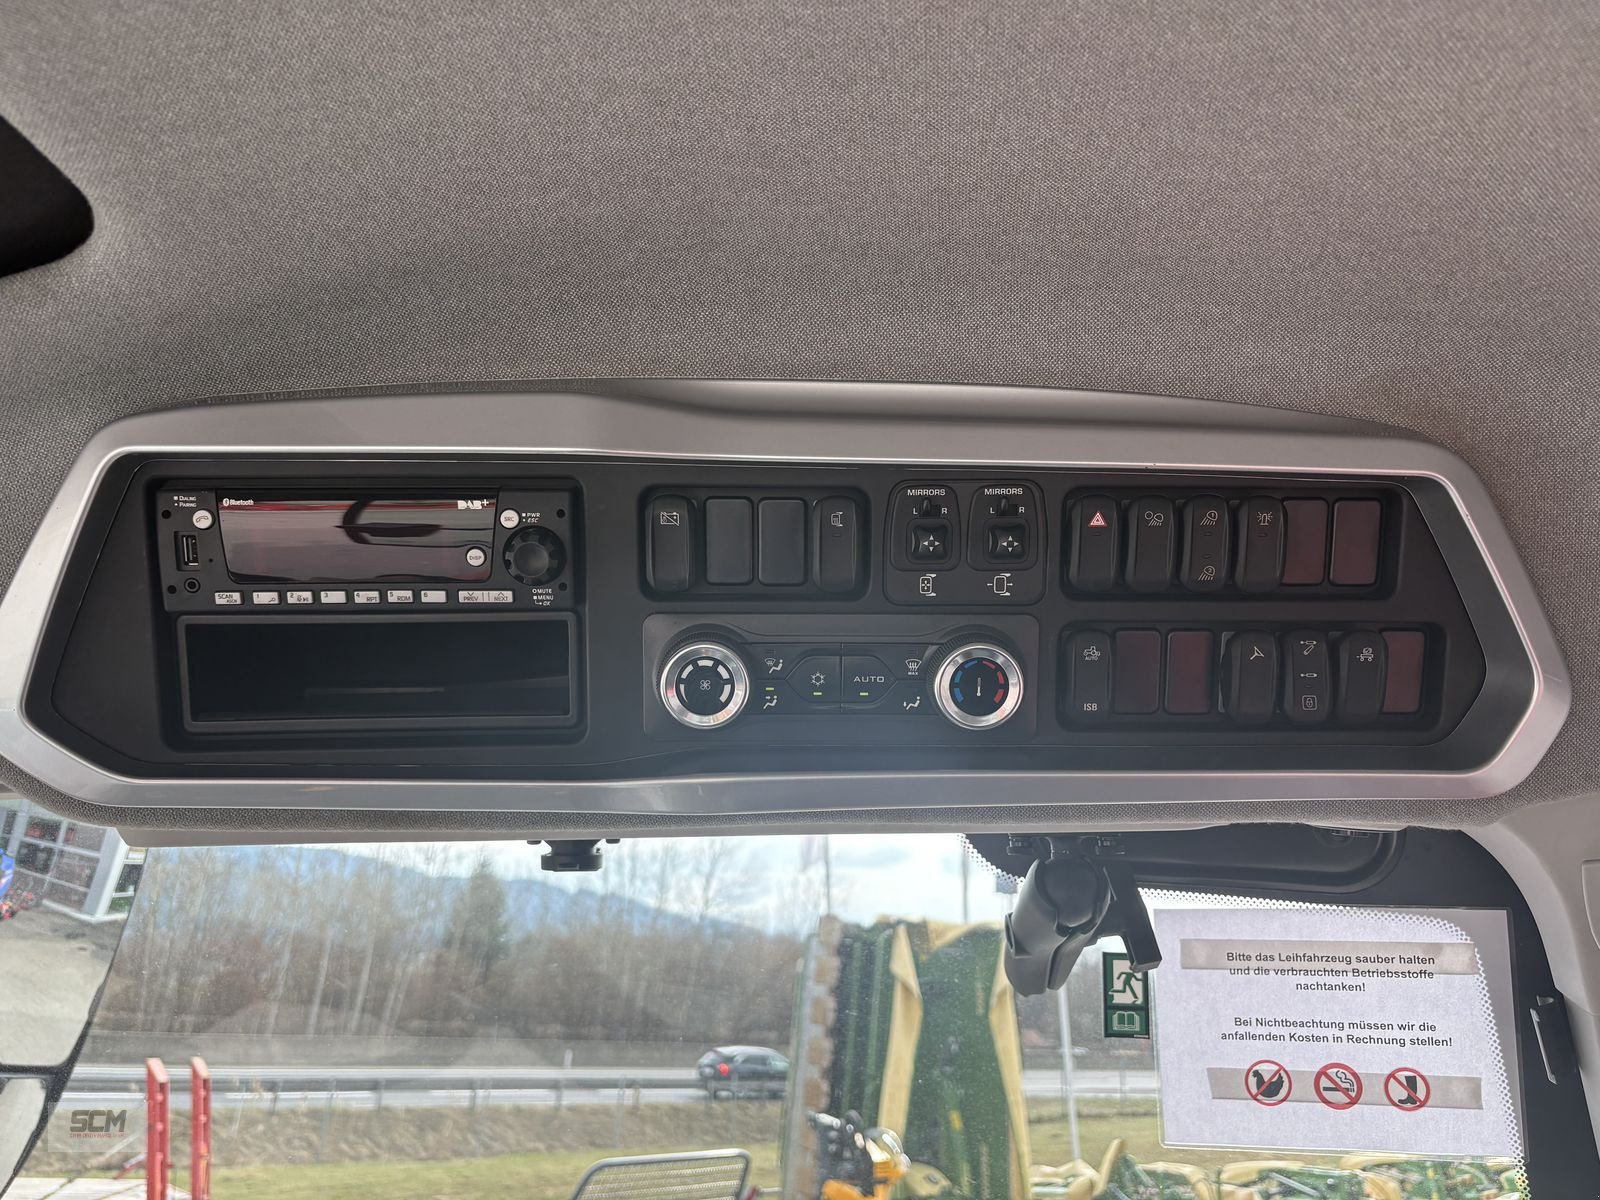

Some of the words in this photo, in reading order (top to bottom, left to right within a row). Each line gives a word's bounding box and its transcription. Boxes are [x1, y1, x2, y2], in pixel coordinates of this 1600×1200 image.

[457, 499, 489, 510] DAB+
[853, 675, 886, 683] AUTO
[1083, 702, 1098, 711] ISB
[1226, 952, 1252, 962] Bitte
[1255, 952, 1275, 962] das
[1278, 952, 1352, 966] Leihfahrzeug
[1355, 954, 1396, 965] sauber
[1398, 954, 1436, 965] halten
[1229, 966, 1251, 976] und
[1253, 966, 1271, 976] die
[1273, 967, 1348, 977] verbrauchten
[1351, 967, 1435, 980] Betriebsstoffe
[1295, 981, 1367, 992] nachtanken!
[1234, 1016, 1253, 1027] Bei
[1255, 1017, 1345, 1032] Nichtbeachtung
[1347, 1020, 1394, 1031] müssen
[1396, 1021, 1416, 1032] wir
[1418, 1022, 1437, 1032] die
[1220, 1031, 1286, 1042] anfallenden
[1288, 1032, 1329, 1043] Kosten
[1332, 1033, 1343, 1043] in
[1346, 1034, 1406, 1048] Rechnung
[1409, 1036, 1453, 1047] stellen!
